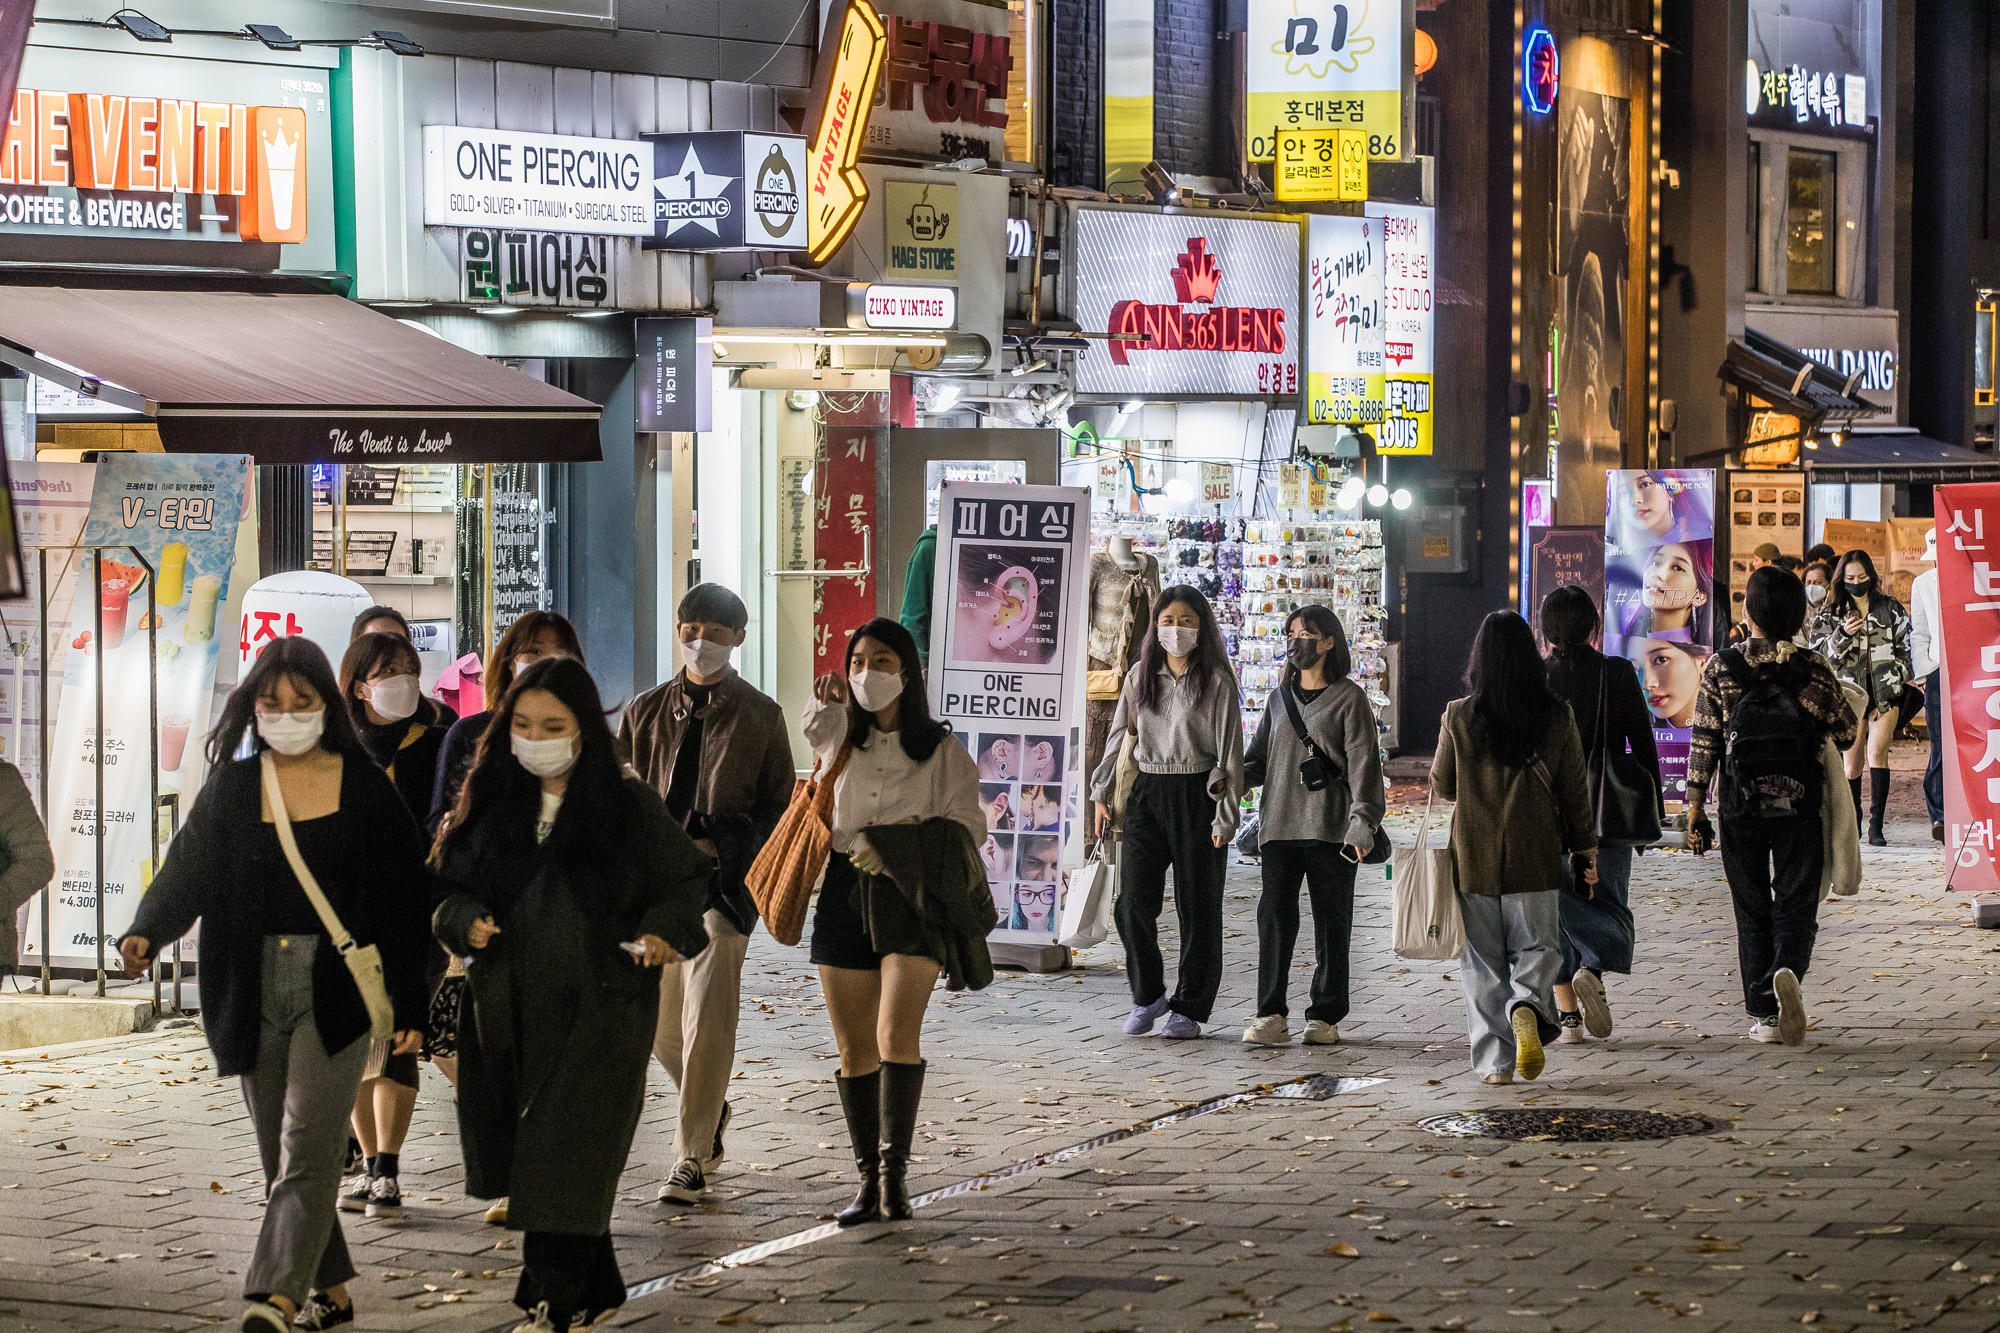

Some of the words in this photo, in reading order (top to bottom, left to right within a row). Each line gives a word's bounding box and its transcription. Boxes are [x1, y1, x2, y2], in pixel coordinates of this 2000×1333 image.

[1284, 100, 1365, 123] 홍대본점
[85, 93, 247, 196] VENTI
[814, 82, 853, 197] VINTAGE
[1283, 138, 1334, 162] 안경
[456, 140, 512, 182] ONE
[523, 146, 641, 192] PIERCING
[1284, 165, 1334, 179] 칼라렌즈
[684, 171, 695, 198] 1
[768, 177, 783, 190] ONE
[450, 193, 475, 213] GOLD
[483, 196, 515, 215] SILVER
[524, 199, 567, 218] TITANIUM
[575, 202, 619, 222] SURGICAL
[621, 205, 648, 224] STEEL
[656, 200, 729, 217] PIERCING
[755, 193, 799, 213] PIERCING
[69, 199, 83, 226] &
[87, 199, 183, 231] BEVERAGE
[465, 231, 608, 302] 원피어싱
[891, 245, 918, 269] HAGI
[919, 248, 955, 270] STORE
[869, 297, 897, 315] ZUKO
[899, 299, 944, 317] VINTAGE
[1391, 287, 1432, 312] STUDIO
[1120, 300, 1184, 366] ANN
[1186, 313, 1218, 350] 365
[1221, 306, 1287, 355] LENS
[665, 366, 676, 403] 피어싱
[1257, 362, 1297, 394] 안경원
[1314, 398, 1384, 421] 02-336-8886
[329, 428, 354, 454] The
[359, 429, 393, 454] Venti
[397, 435, 409, 453] is
[413, 428, 447, 453] Love
[1376, 417, 1418, 449] LOUIS
[1204, 482, 1231, 501] SALE
[1655, 482, 1681, 490] WATCH
[1682, 482, 1693, 490] ME
[1694, 481, 1711, 490] NOW
[1310, 489, 1325, 507] SALE
[957, 501, 1070, 539] 피어싱
[493, 527, 535, 547] Titanium
[1608, 548, 1632, 556] Estelle
[493, 586, 554, 609] Bodypiercing
[1614, 588, 1704, 607] #ASTRA
[983, 674, 1023, 693] ONE
[945, 694, 1057, 718] PIERCING
[105, 740, 126, 751] 주스
[104, 811, 135, 823] 크러쉬
[63, 870, 77, 878] 생기
[62, 881, 92, 893] 벤타민
